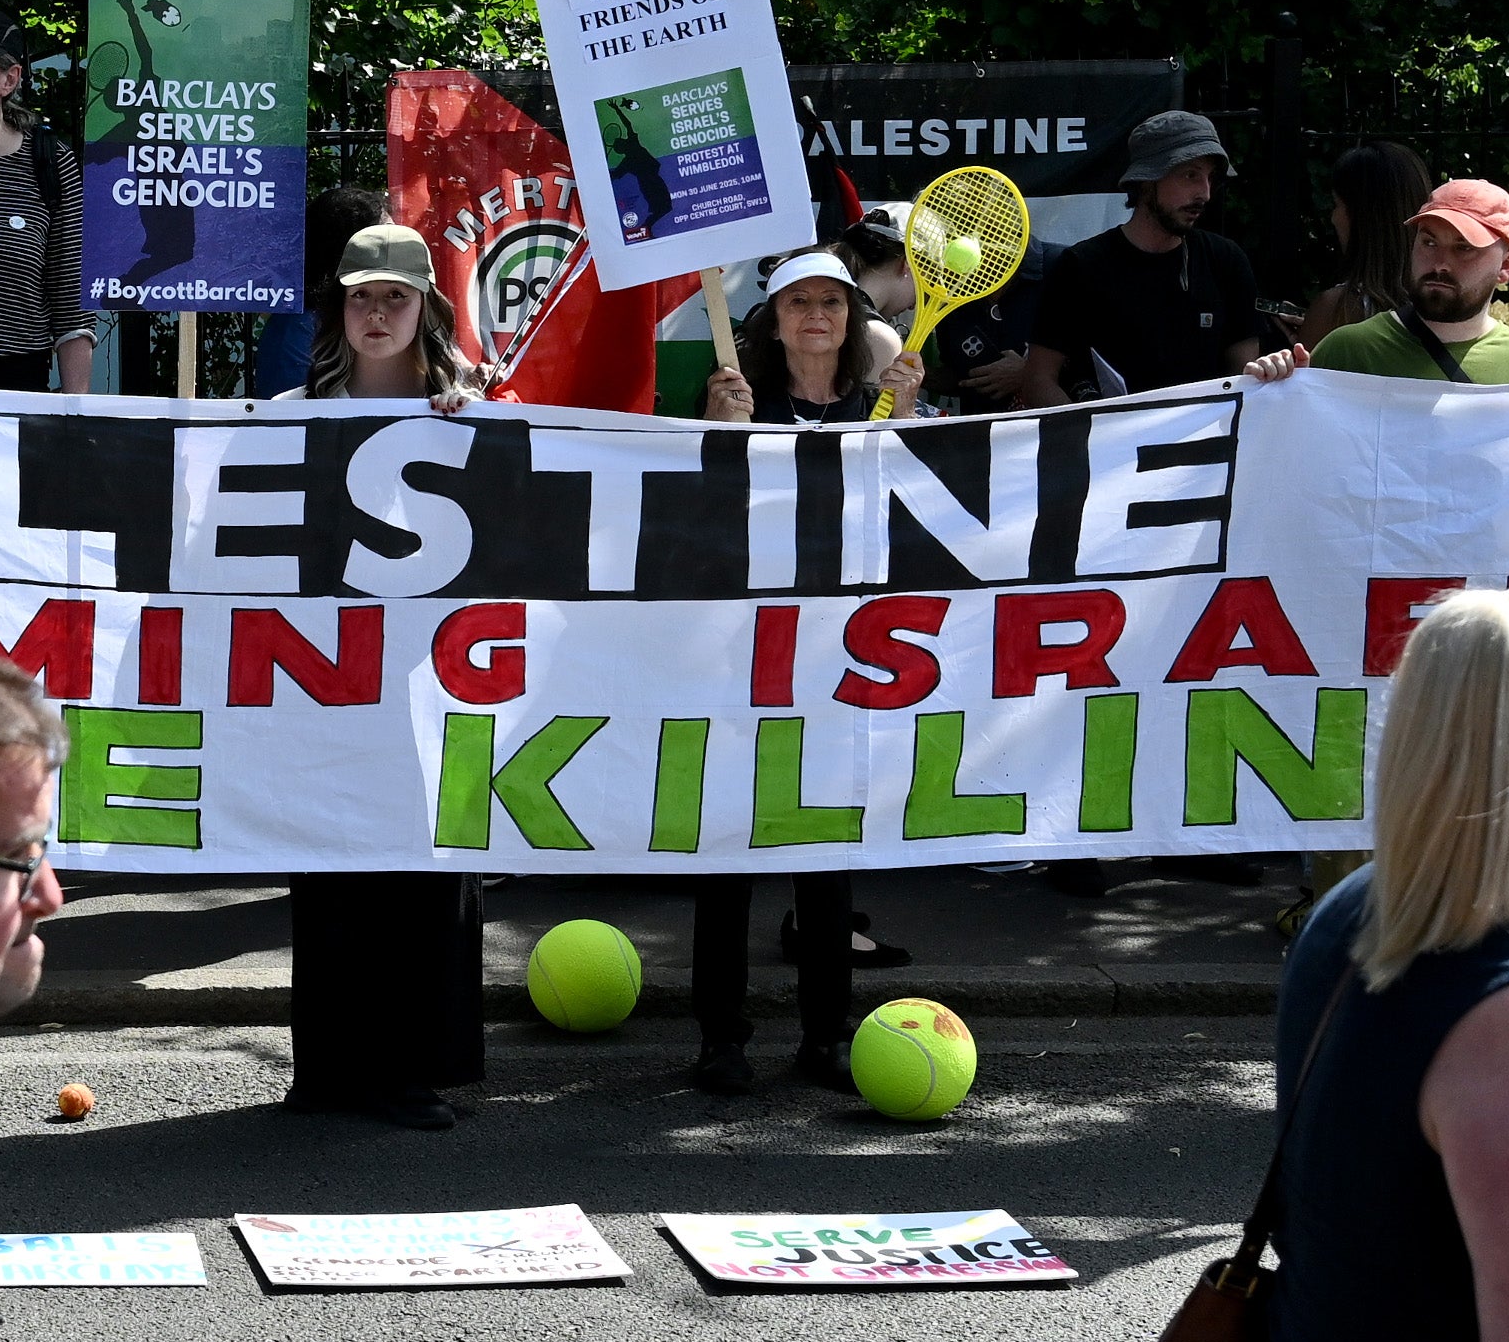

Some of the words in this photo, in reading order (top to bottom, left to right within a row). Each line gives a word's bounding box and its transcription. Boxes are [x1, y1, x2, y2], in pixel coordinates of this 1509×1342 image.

[585, 34, 636, 60] THE
[643, 12, 728, 48] EARTH
[116, 79, 276, 110] BARCLAYS
[662, 81, 728, 108] BARCLAYS
[671, 97, 723, 120] SERVES
[137, 113, 255, 143] SERVES
[671, 111, 730, 135] ISRAEL'S
[670, 124, 738, 150] GENOCIDE
[801, 117, 1088, 157] ALESTINE
[127, 145, 263, 175] ISRAEL'S
[677, 145, 725, 166] PROTEST
[727, 143, 740, 155] AT
[678, 155, 745, 178] WIMBLEDON
[112, 178, 275, 208] GENOCIDE
[670, 190, 688, 200] MON
[699, 183, 718, 194] JUNE
[719, 178, 740, 189] 2025,
[741, 173, 762, 184] 10AM
[443, 176, 577, 254] MERT
[674, 215, 689, 224] OPP
[690, 209, 718, 221] CENTRE
[719, 202, 746, 214] COURT,
[747, 196, 768, 208] SW19
[691, 200, 722, 212] CHURCH
[723, 194, 746, 205] ROAD,
[90, 277, 295, 306] #BoycottBarclays
[432, 685, 1368, 854] KILLIN
[729, 1226, 933, 1249] SERVE
[292, 1256, 452, 1265] GENOCIDE
[774, 1239, 1053, 1267] JUSTICE
[409, 1262, 603, 1277] APARTHEID
[708, 1262, 811, 1278] NOT
